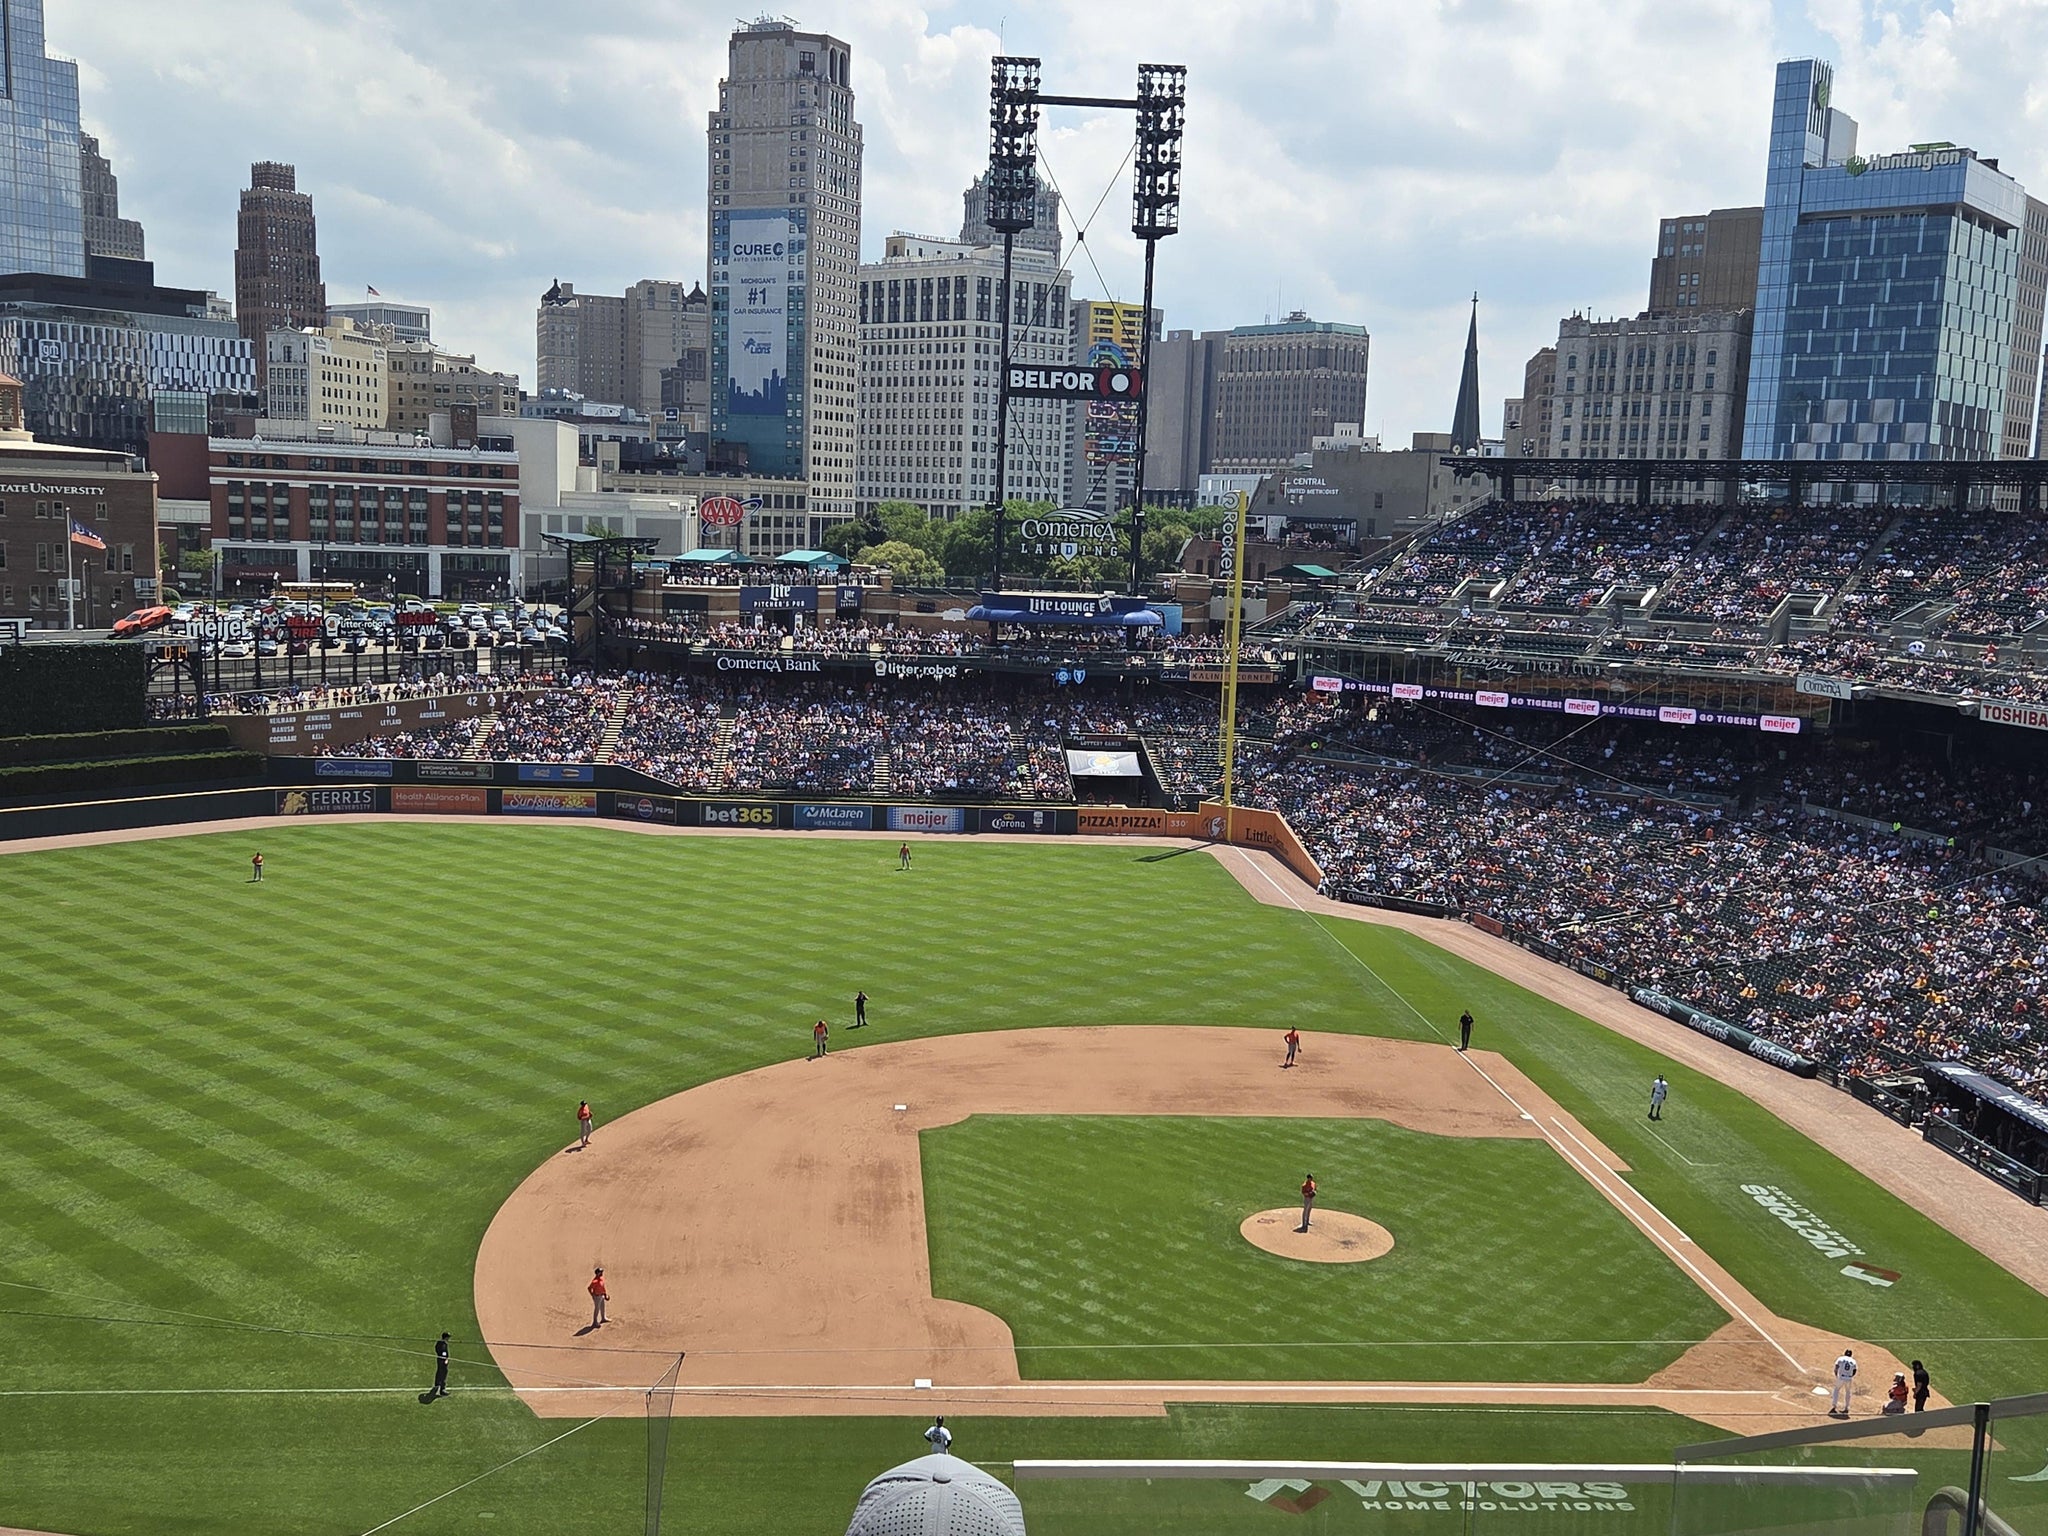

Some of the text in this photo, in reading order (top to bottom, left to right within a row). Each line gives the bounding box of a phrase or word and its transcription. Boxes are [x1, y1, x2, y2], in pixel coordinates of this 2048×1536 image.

[1868, 151, 1961, 172] Huntington
[733, 244, 772, 256] CURE
[747, 287, 768, 305] #1
[1009, 369, 1095, 391] BELFOR
[1293, 478, 1327, 486] CENTRAL
[28, 483, 105, 496] UNIVERSITY
[1306, 488, 1340, 496] METHODIST
[702, 499, 743, 524] AAA
[1220, 511, 1239, 578] Rocket
[1020, 542, 1119, 563] LANDING
[769, 583, 791, 601] Lite
[753, 600, 806, 608] PITCHER'S PUB
[1029, 598, 1096, 614] Lite LOUNGE
[186, 617, 249, 641] meijer
[412, 624, 438, 636] LAW
[785, 659, 822, 673] Bank
[1525, 660, 1601, 677] TIGER CLUB
[1315, 679, 1340, 690] meijer
[1344, 682, 1390, 694] GO TIGERS!
[1395, 686, 1421, 698] meijer
[1425, 690, 1474, 701] GO TIGERS!
[428, 700, 437, 710] 11
[466, 696, 478, 707] 42
[1478, 693, 1505, 705] meijer
[1511, 697, 1562, 710] GO TIGERS!
[386, 705, 396, 716] 10
[1568, 701, 1596, 713] meijer
[1602, 706, 1657, 718] GO TIGERS!
[419, 711, 446, 719] ANDERSON
[1663, 709, 1693, 722] meijer
[1699, 715, 1757, 727] GO TIGERS!
[1983, 705, 2048, 728] TOSHIBA
[380, 719, 401, 727] LEYLAND
[1764, 717, 1796, 731] meijer
[318, 768, 390, 777] Foundation Restoration
[311, 790, 372, 805] FERRIS
[395, 792, 481, 802] Health Alliance Plan
[510, 793, 561, 809] Surfside
[617, 801, 636, 811] PEPSI
[655, 806, 674, 815] PEPSI
[705, 806, 773, 824] bet365
[818, 807, 864, 820] McLaren
[903, 811, 948, 829] meijer
[991, 818, 1026, 830] Corona
[1079, 816, 1162, 829] PIZZA! PIZZA!
[1245, 828, 1273, 843] Little
[1688, 1013, 1729, 1041] Dunham's
[1740, 1184, 1850, 1258] VICTORS
[1766, 1184, 1867, 1256] HOME SOLUTIONS
[1339, 1479, 1629, 1499] VICTORS
[1361, 1500, 1637, 1512] HOME SOLUTIONS
